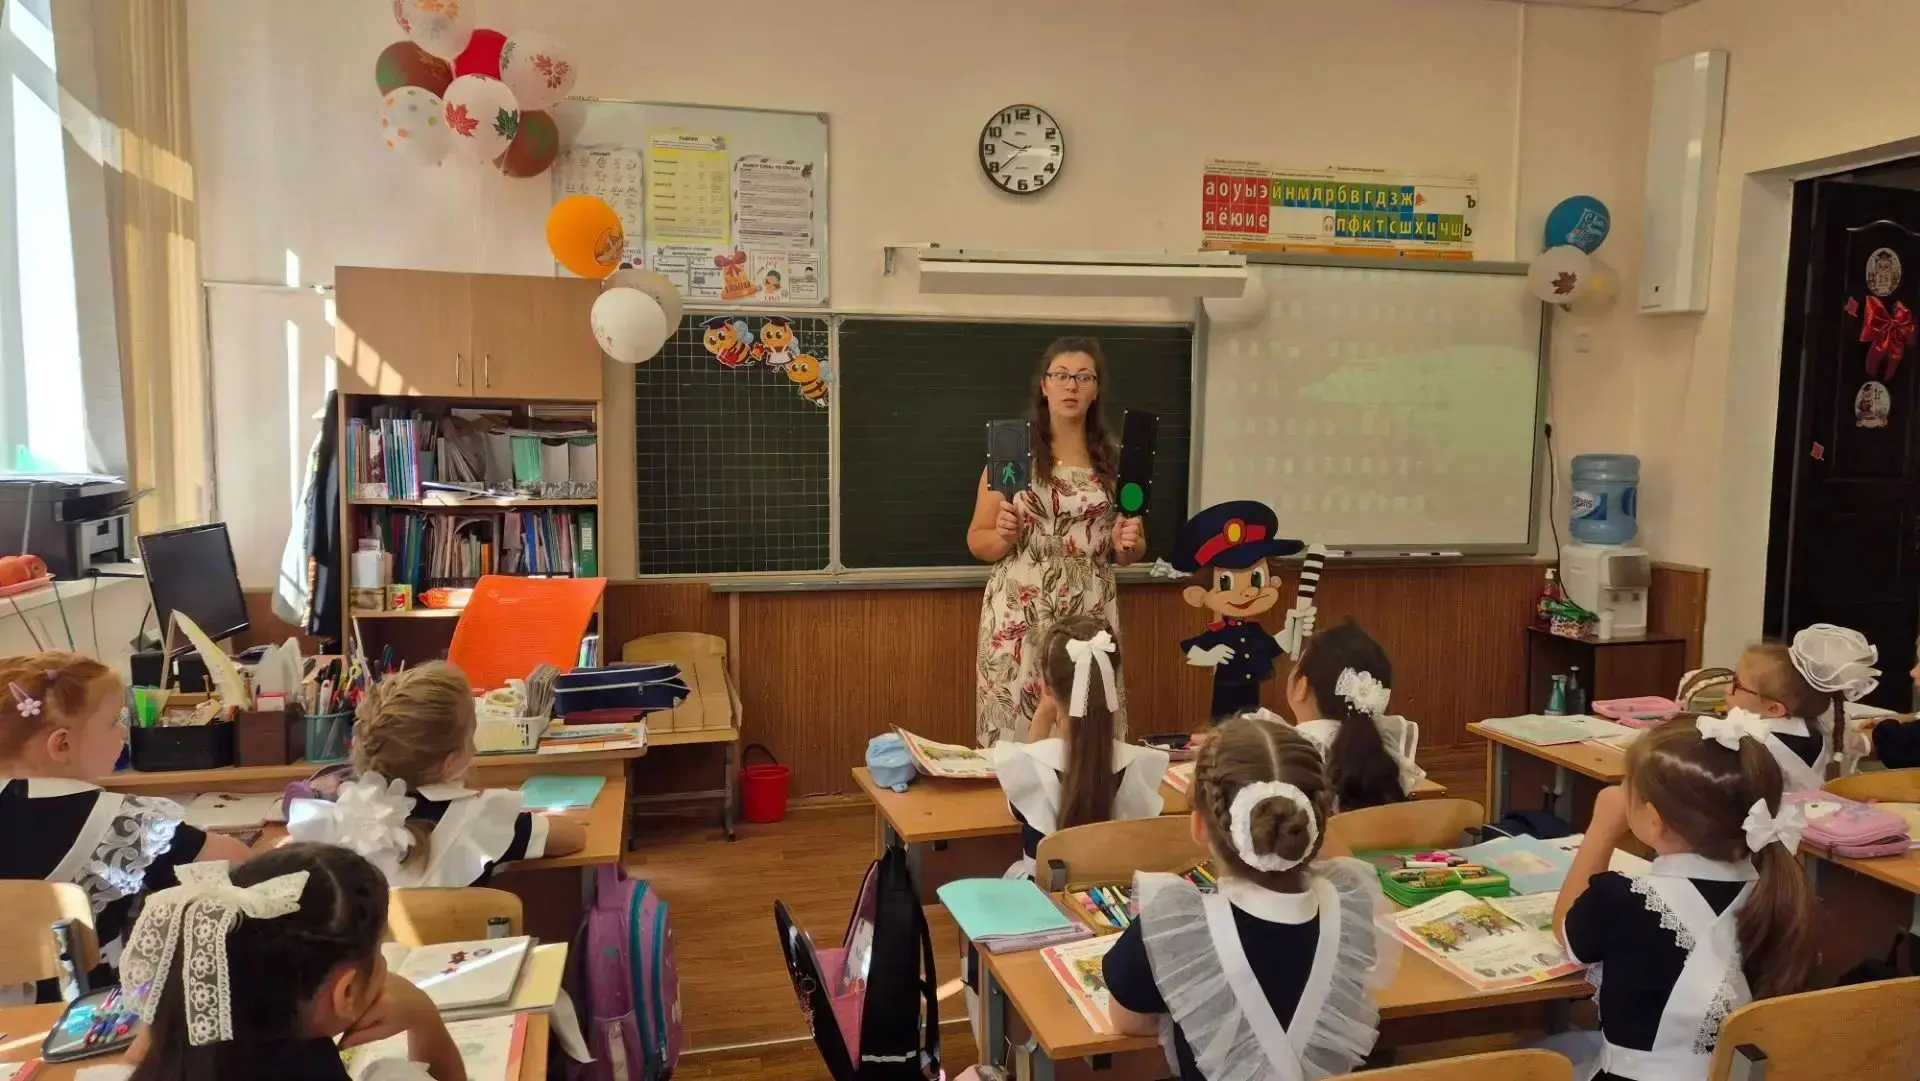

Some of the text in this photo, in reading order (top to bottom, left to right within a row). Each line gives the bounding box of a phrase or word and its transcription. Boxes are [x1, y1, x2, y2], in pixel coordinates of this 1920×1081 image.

[1000, 113, 1011, 124] 11
[1014, 108, 1030, 120] 12
[1036, 114, 1041, 125] 1
[989, 127, 1002, 138] 10
[1045, 128, 1056, 140] 2
[984, 144, 995, 155] 9
[1050, 145, 1060, 156] 3
[989, 162, 1000, 172] 8
[1043, 163, 1055, 173] 4
[1002, 175, 1012, 185] 7
[1017, 180, 1028, 190] 6
[1034, 175, 1044, 186] 5
